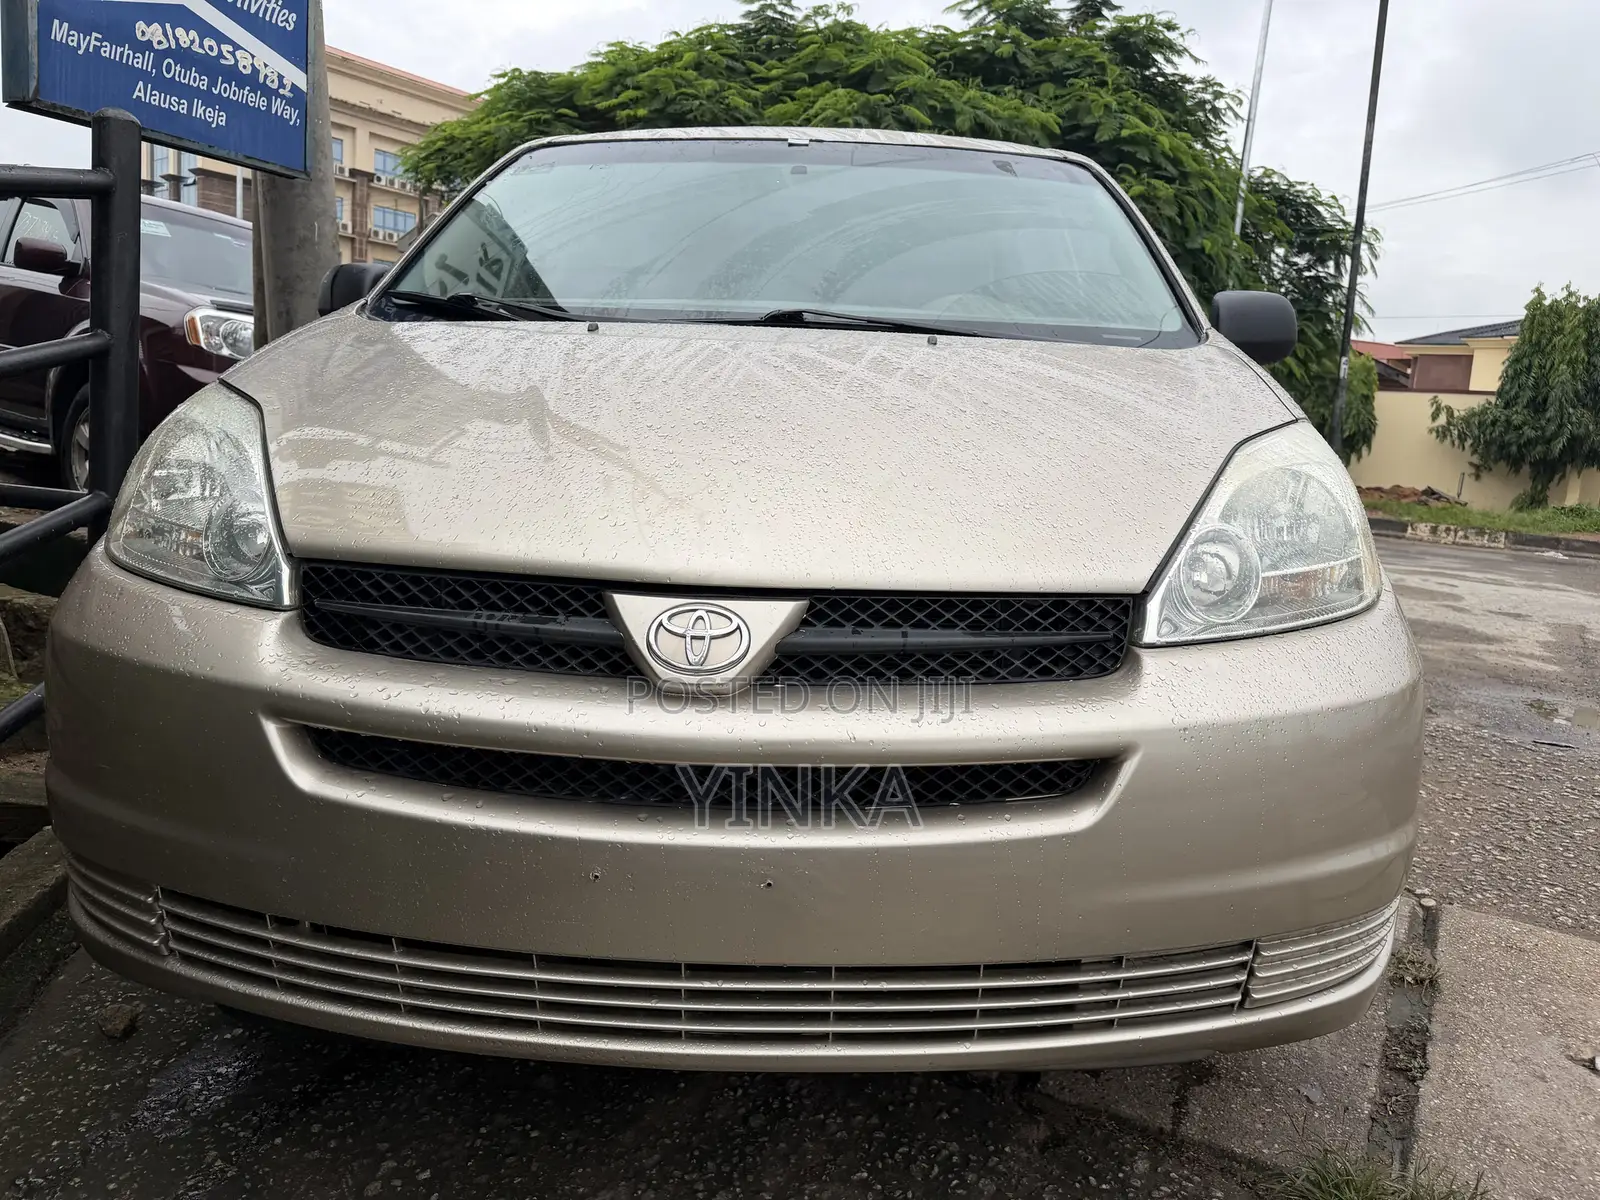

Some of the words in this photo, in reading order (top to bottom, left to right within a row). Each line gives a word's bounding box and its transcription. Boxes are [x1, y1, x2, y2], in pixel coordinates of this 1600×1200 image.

[227, 0, 297, 31] ivities
[132, 80, 188, 115] Alausa
[192, 97, 227, 128] Ikeja
[162, 57, 208, 91] Otuba
[271, 97, 301, 126] Way,
